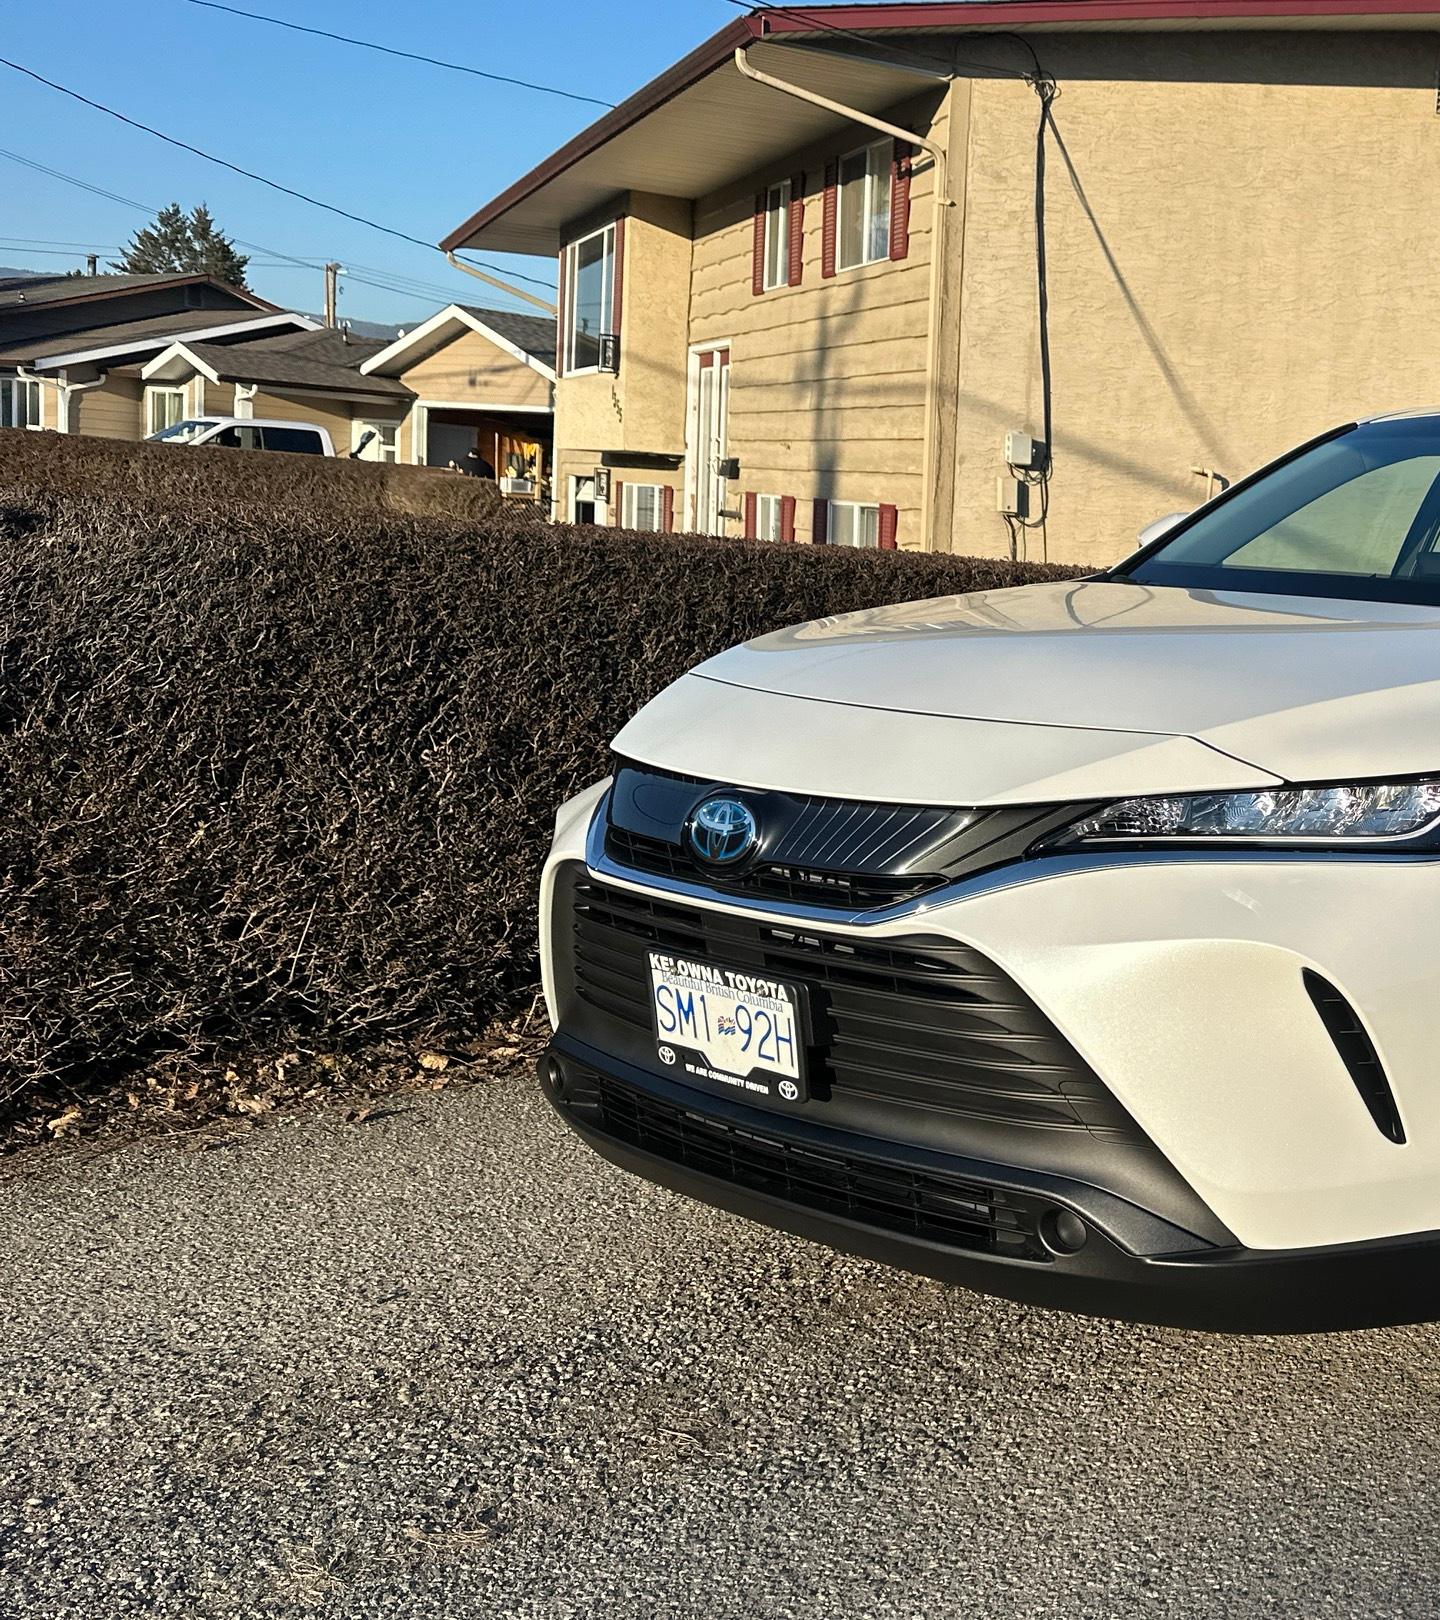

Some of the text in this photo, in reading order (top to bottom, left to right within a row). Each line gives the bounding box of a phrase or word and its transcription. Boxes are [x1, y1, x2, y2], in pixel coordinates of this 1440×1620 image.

[661, 971, 784, 1013] Beautiful British Columbia
[724, 971, 788, 1001] TOYOTA
[657, 985, 794, 1069] SM1 92H
[685, 1063, 769, 1095] WE ARE COMMUNITY DRIVEN
